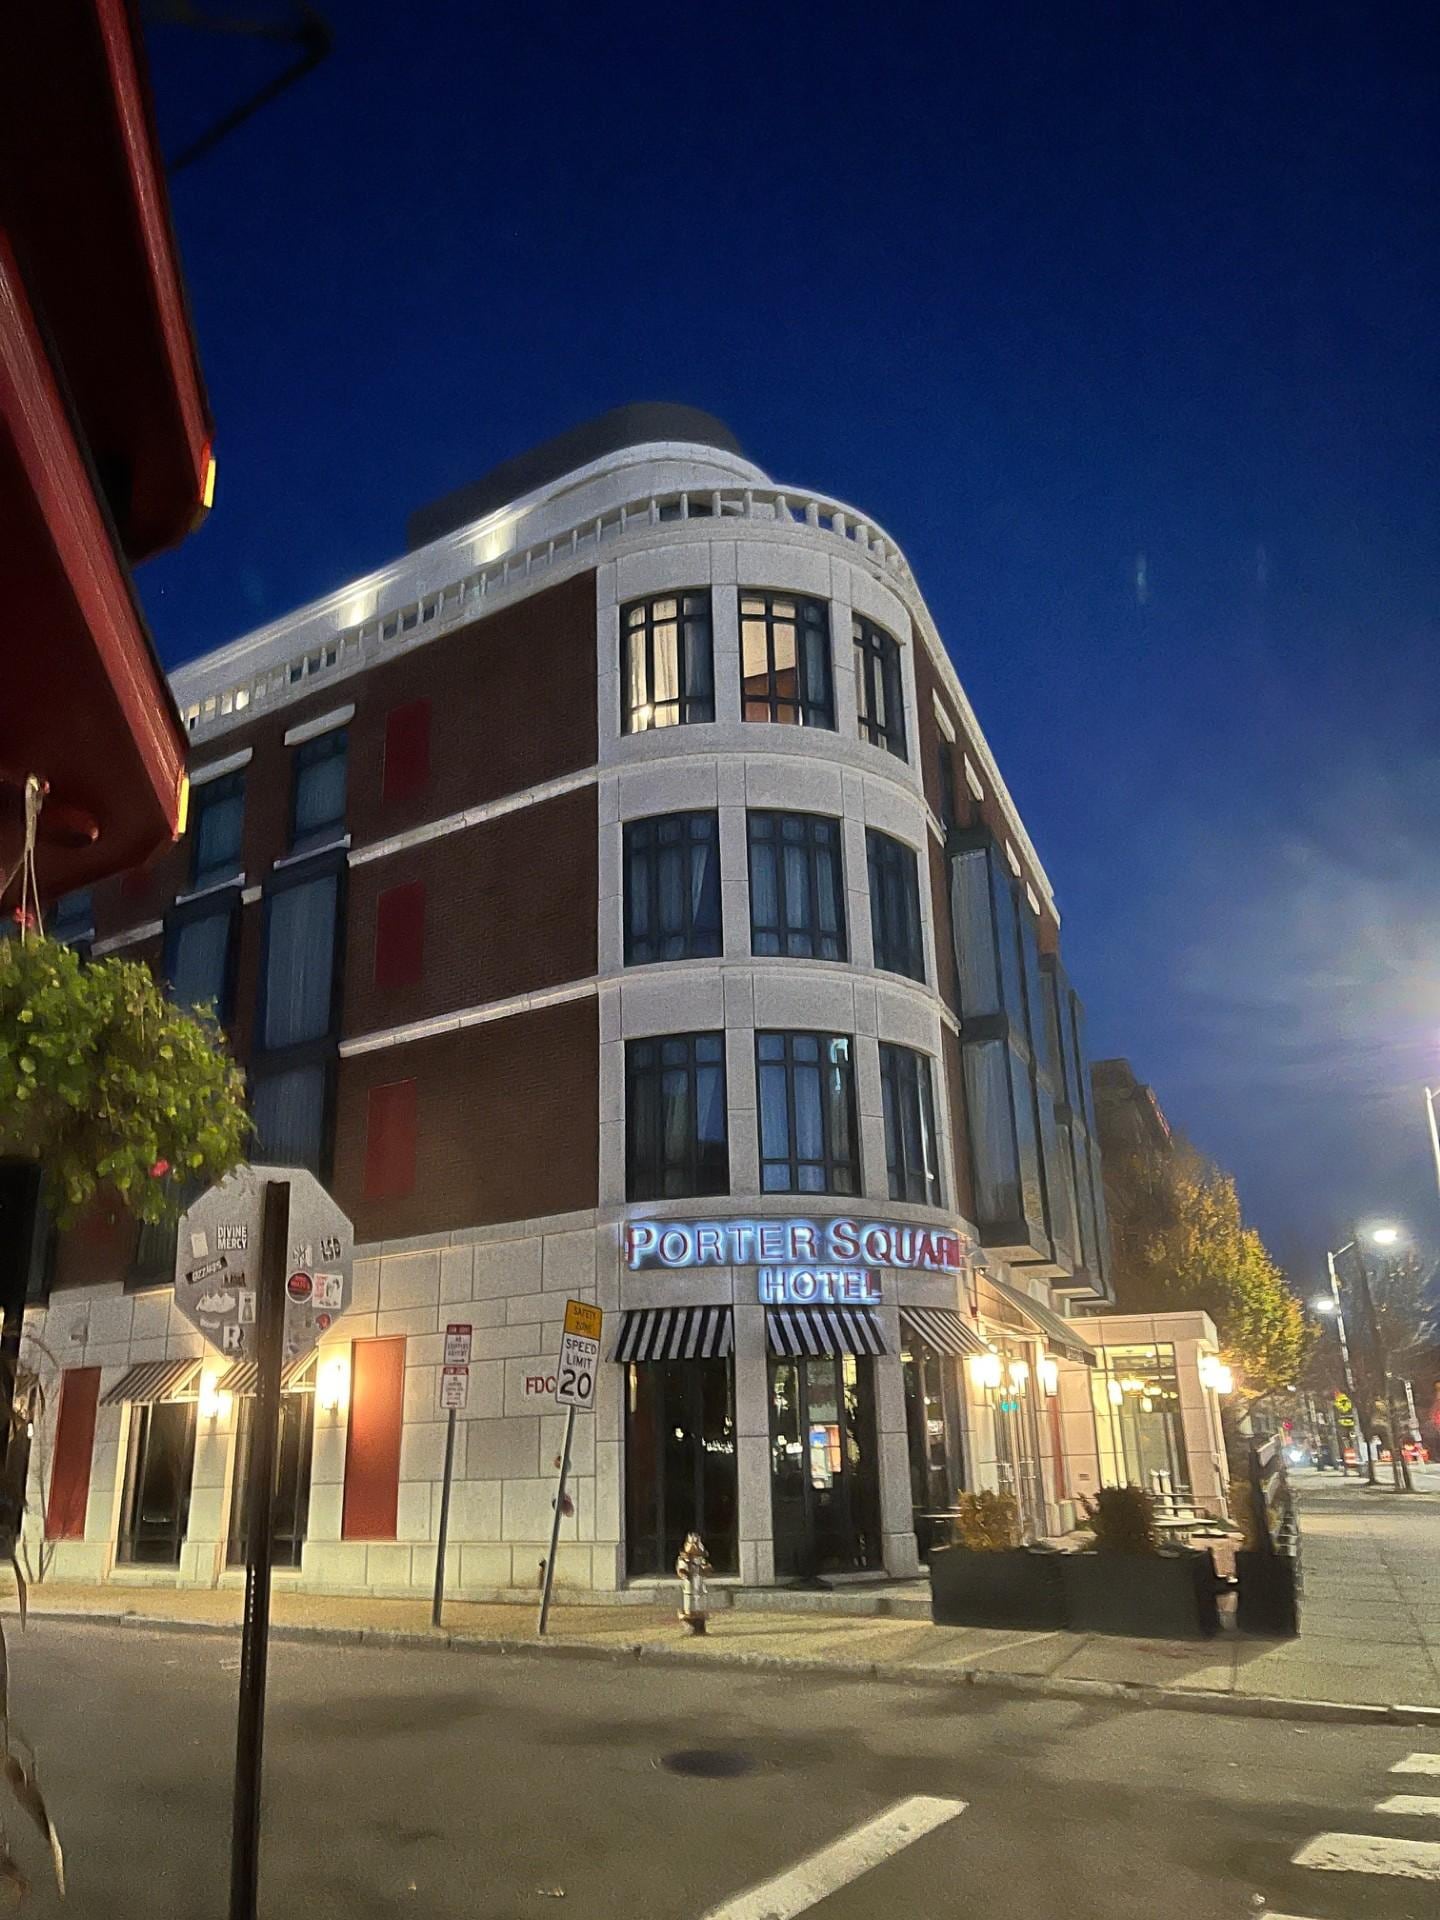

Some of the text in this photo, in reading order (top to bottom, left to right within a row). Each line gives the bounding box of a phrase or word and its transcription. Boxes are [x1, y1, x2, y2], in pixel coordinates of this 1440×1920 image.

[217, 1225, 247, 1238] DIVINE
[217, 1238, 247, 1249] MERCY
[626, 1222, 818, 1268] PORTER
[762, 1267, 881, 1303] HOTEL
[566, 1339, 597, 1355] SPEED
[567, 1354, 592, 1369] LIMIT
[525, 1376, 557, 1395] FDC
[560, 1369, 592, 1399] 20
